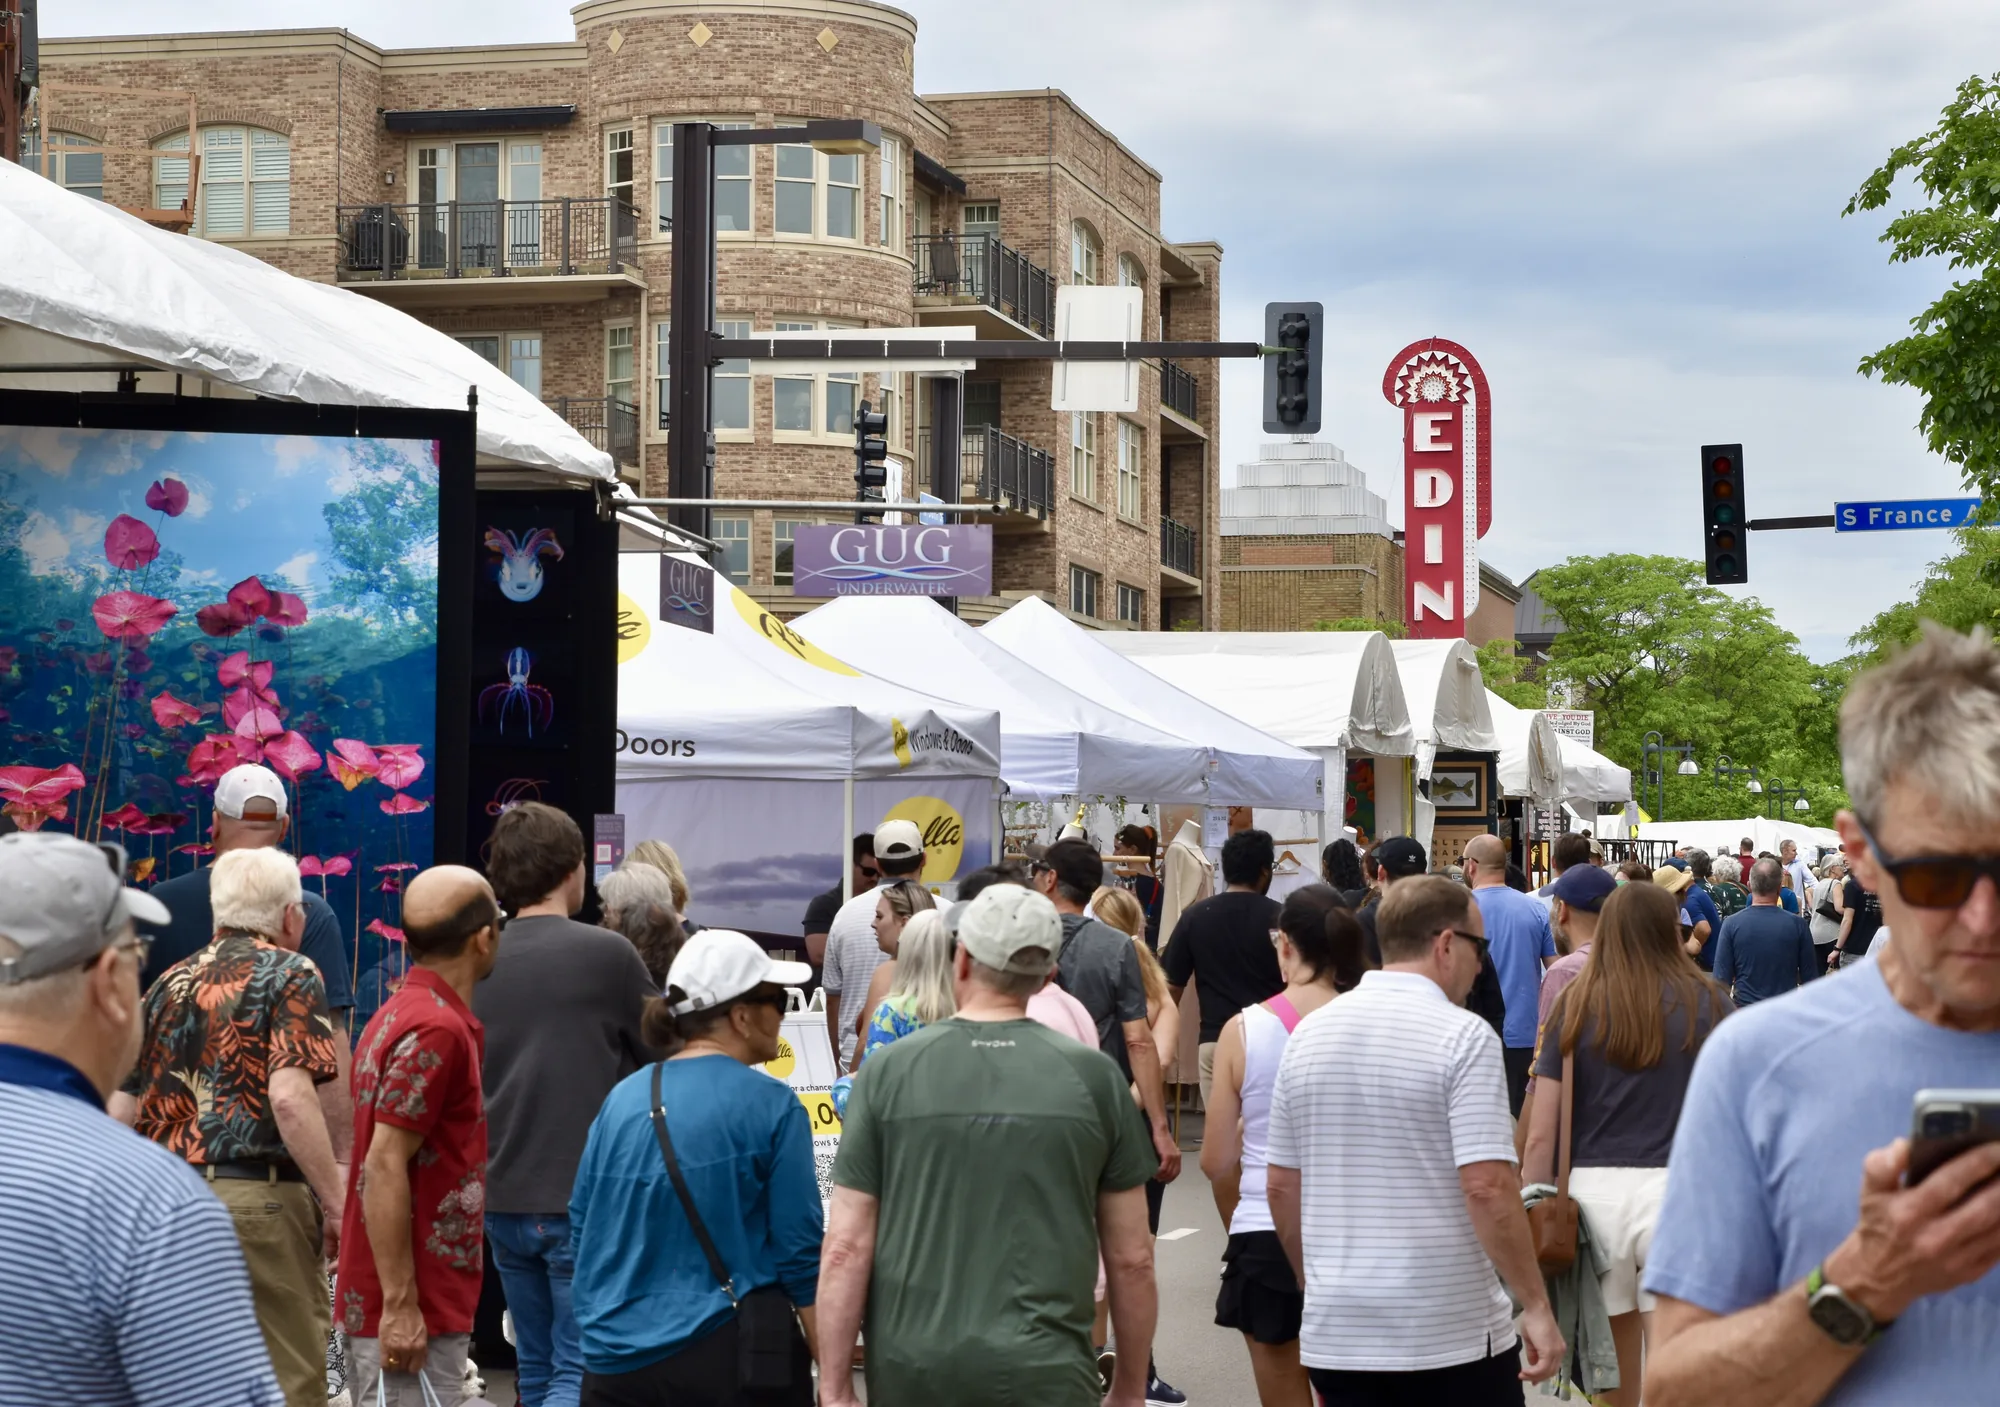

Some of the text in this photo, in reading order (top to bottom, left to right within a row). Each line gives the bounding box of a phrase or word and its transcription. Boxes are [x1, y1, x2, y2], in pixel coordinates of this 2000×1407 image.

[1413, 411, 1454, 621] EDIN
[1843, 508, 1857, 526] S
[1869, 507, 1952, 525] France
[830, 527, 953, 565] GUG
[670, 561, 704, 602] GUG
[909, 725, 942, 753] Windows
[943, 728, 950, 751] &
[950, 728, 974, 755] Doors
[922, 816, 961, 848] lla
[806, 1084, 832, 1092] chance
[814, 1139, 832, 1147] ows
